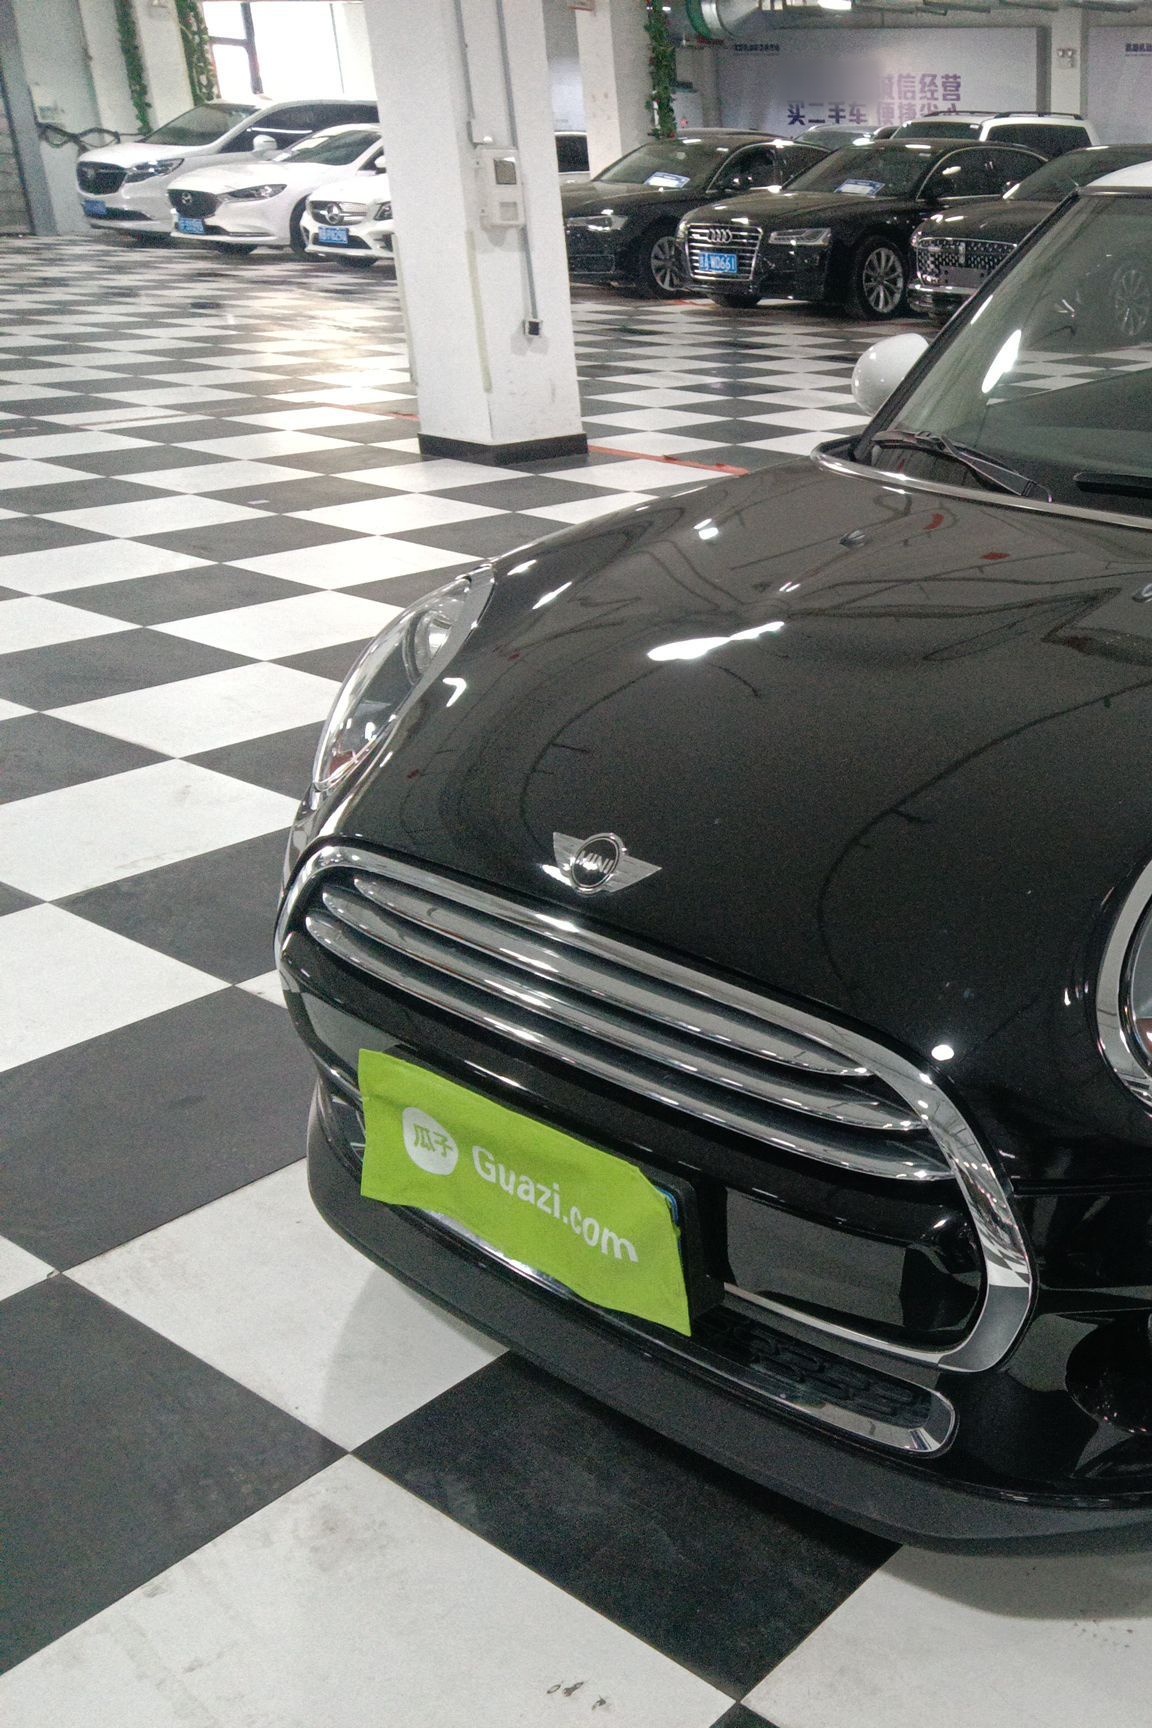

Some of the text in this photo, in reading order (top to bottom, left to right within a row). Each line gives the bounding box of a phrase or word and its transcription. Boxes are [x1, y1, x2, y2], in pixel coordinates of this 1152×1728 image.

[786, 101, 868, 126] 买二手车
[412, 1123, 454, 1159] 瓜子
[471, 1144, 640, 1264] Guazi.com
